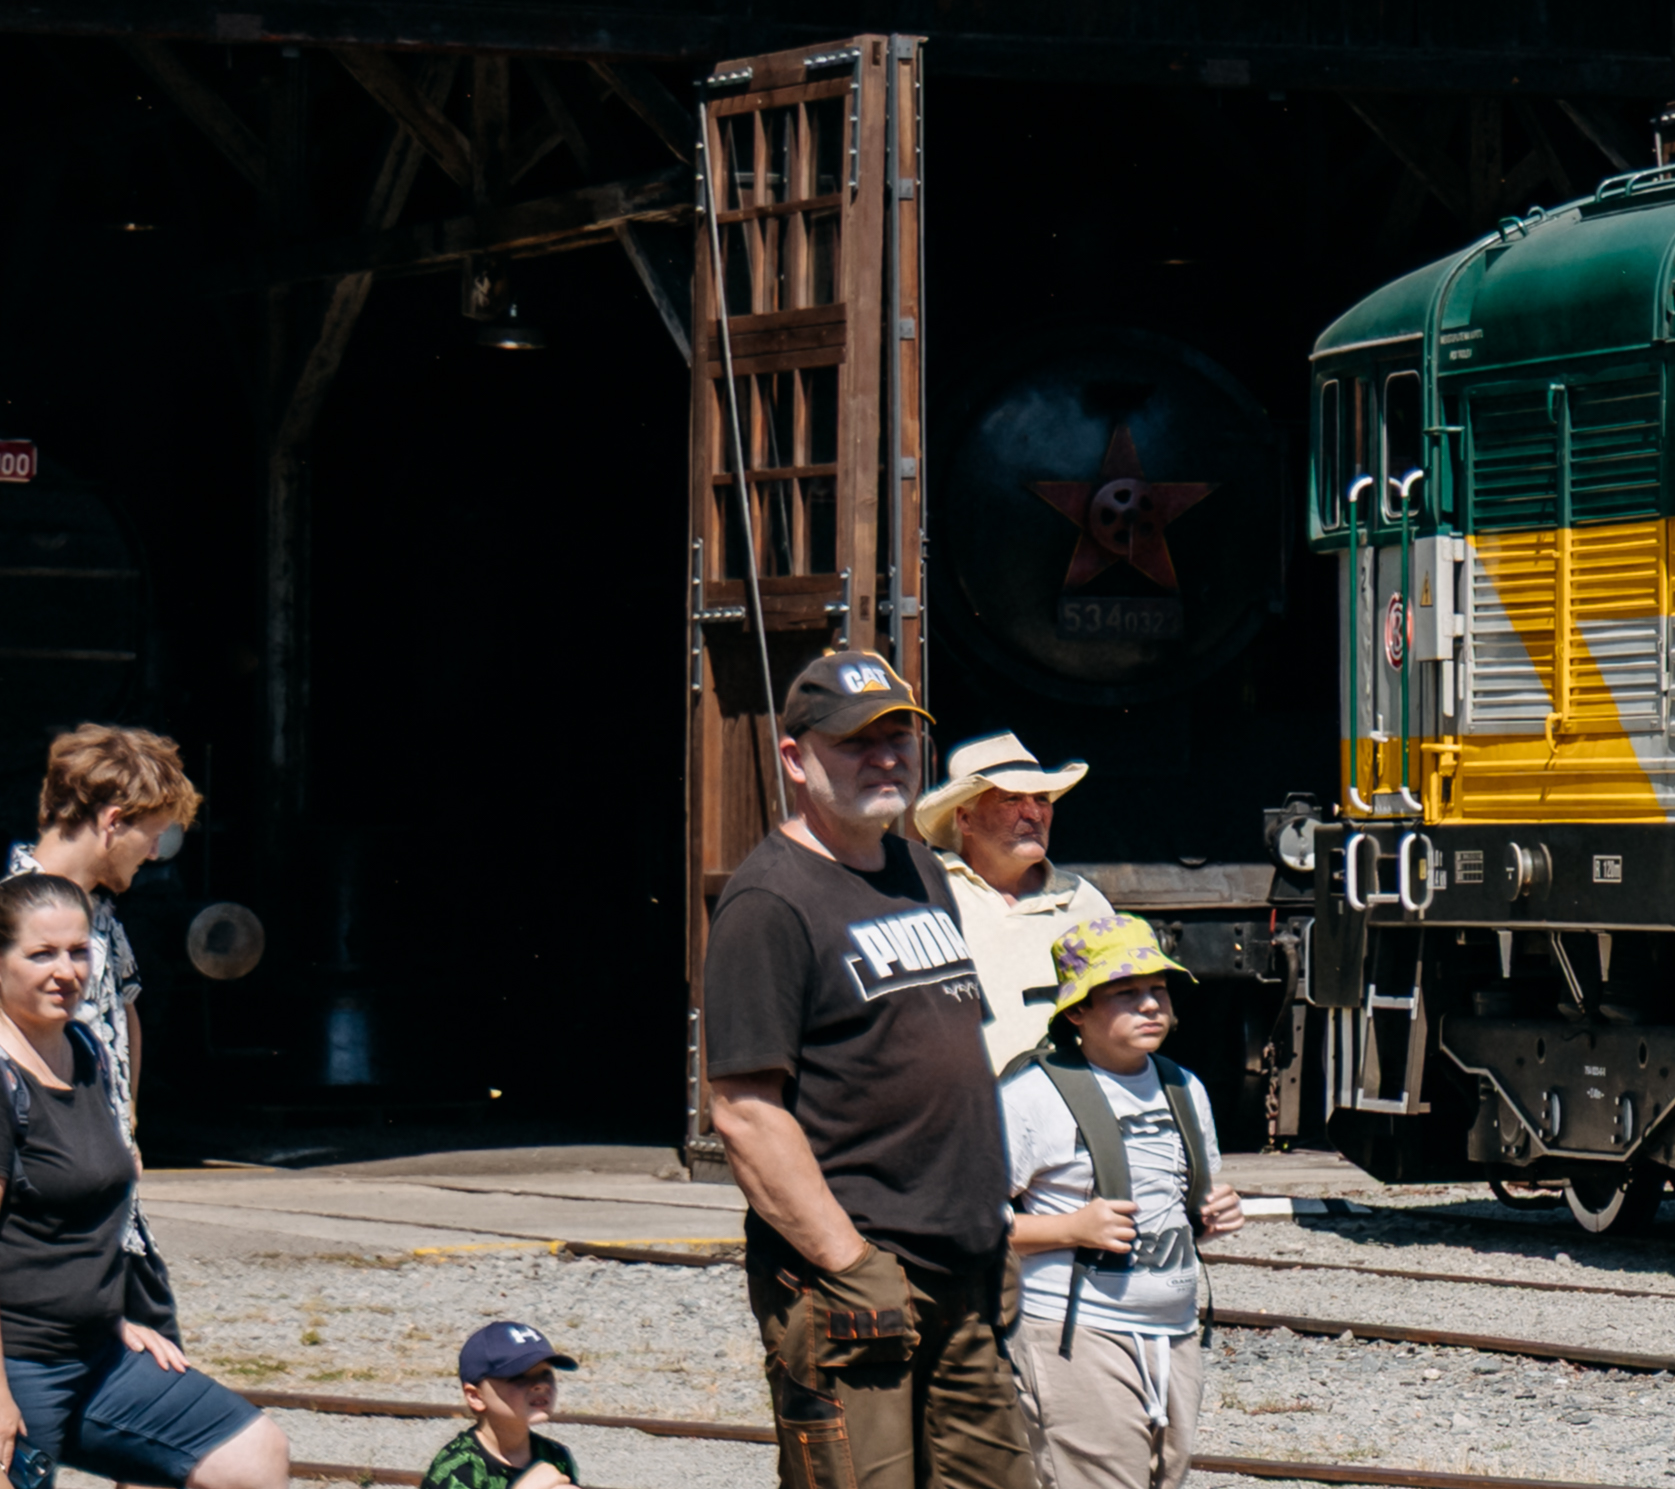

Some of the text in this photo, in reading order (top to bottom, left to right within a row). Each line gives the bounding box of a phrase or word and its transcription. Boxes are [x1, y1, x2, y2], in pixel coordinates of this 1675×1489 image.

[0, 453, 30, 477] 00
[843, 664, 891, 694] CAT
[853, 910, 973, 978] PUMA
